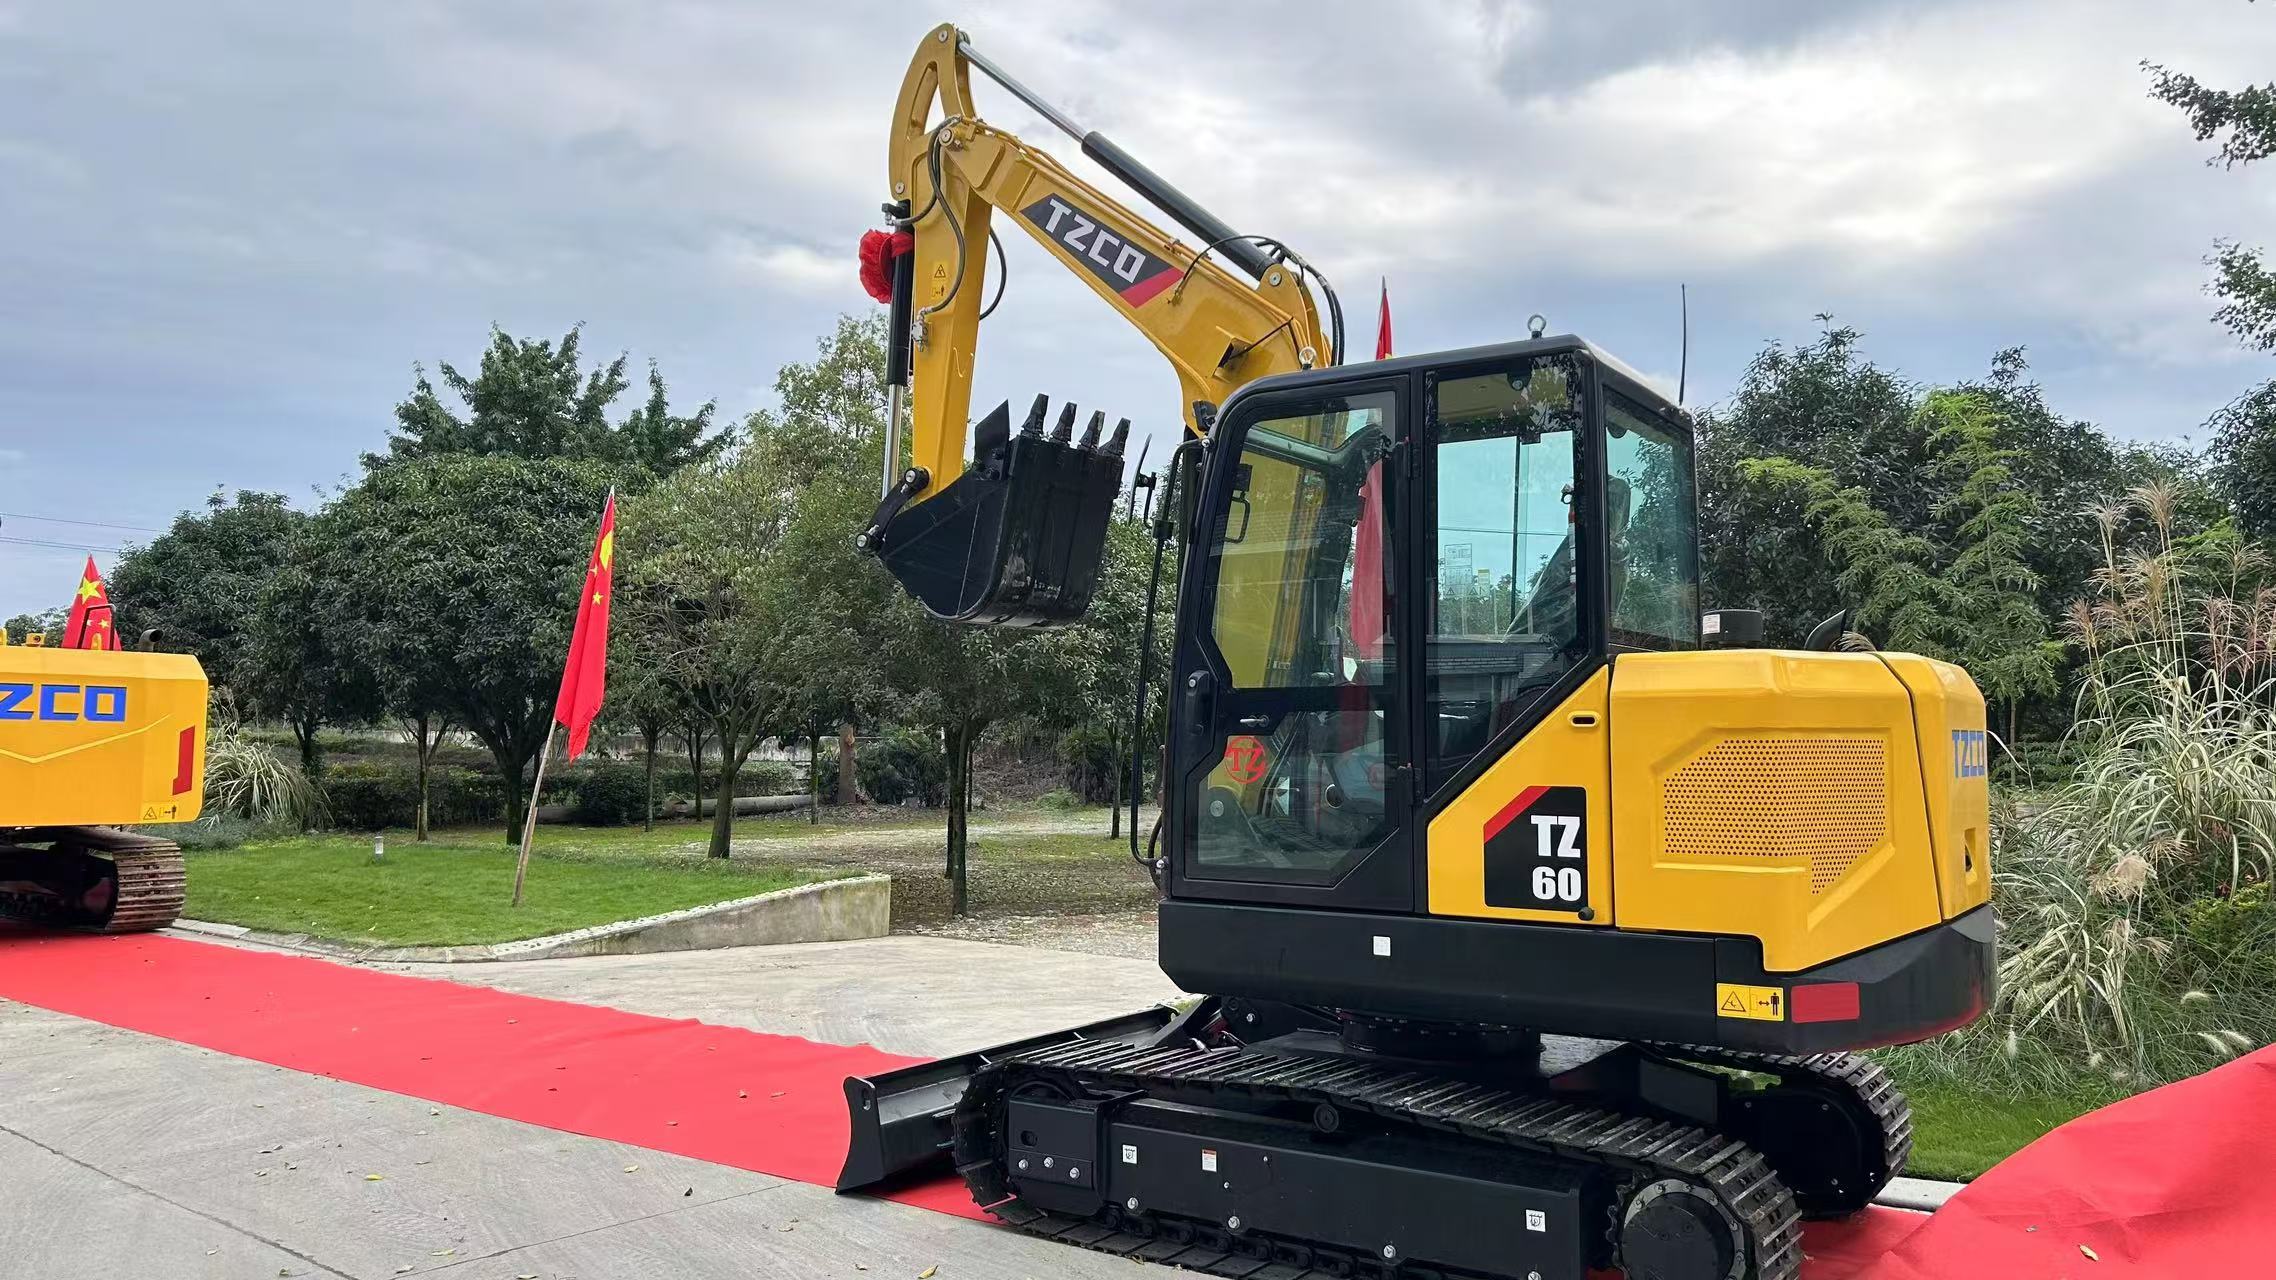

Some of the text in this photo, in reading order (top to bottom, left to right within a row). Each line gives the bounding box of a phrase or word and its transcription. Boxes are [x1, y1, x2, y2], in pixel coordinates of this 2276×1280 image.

[1045, 198, 1147, 284] TZCO
[1951, 729, 1985, 778] TZCO
[1530, 814, 1581, 858] TZ
[1532, 866, 1582, 902] 60
